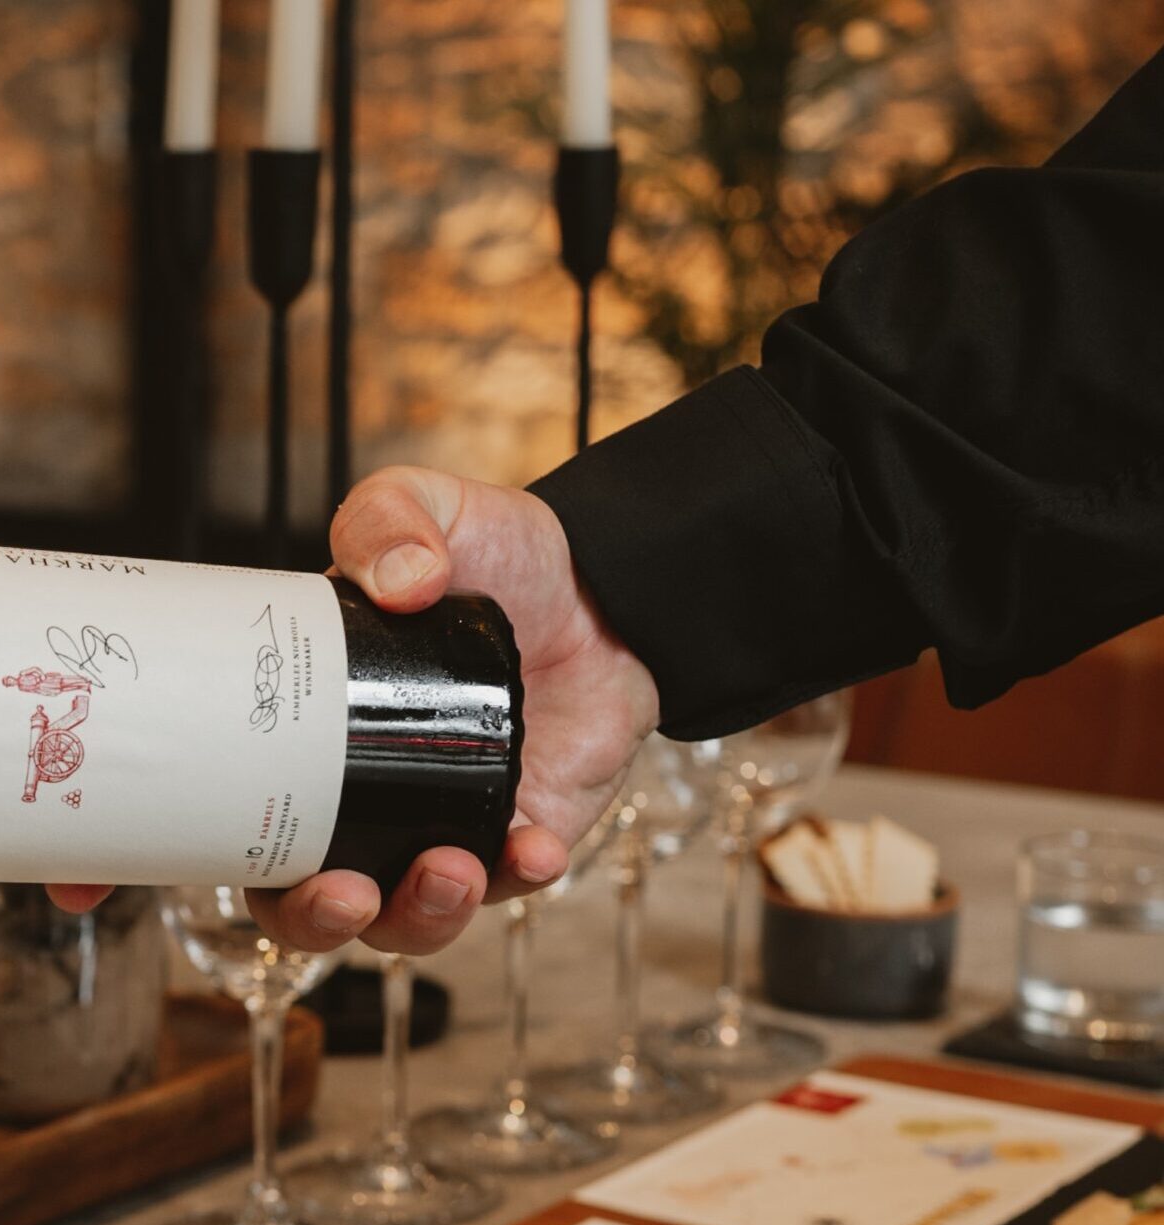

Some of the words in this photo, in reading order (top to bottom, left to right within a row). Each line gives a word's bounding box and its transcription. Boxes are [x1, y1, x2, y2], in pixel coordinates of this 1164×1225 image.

[290, 616, 299, 660] NICHOLLS
[304, 637, 312, 696] WINEMAKER
[292, 664, 301, 721] KIMBERLEE
[260, 797, 276, 840] BARRELS
[276, 793, 292, 839] VINEYARD
[279, 848, 291, 866] NAPA
[286, 816, 299, 848] VALLEY
